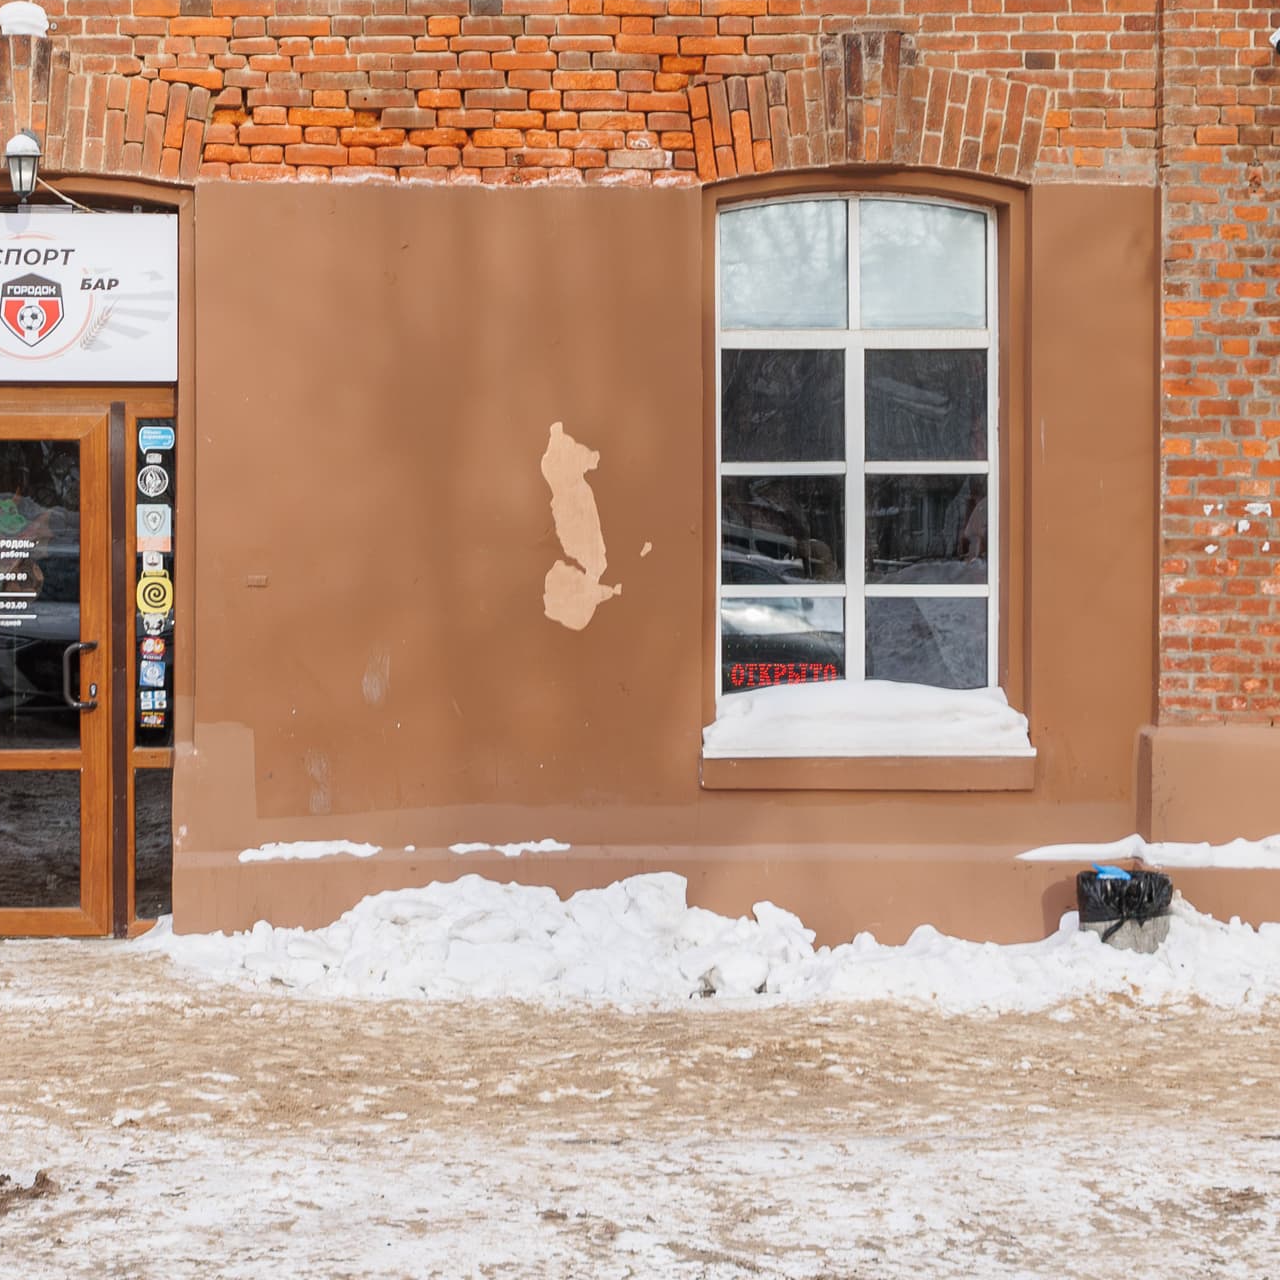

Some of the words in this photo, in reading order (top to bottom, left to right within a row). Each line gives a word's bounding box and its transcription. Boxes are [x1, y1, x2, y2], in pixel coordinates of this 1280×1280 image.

[80, 278, 119, 291] БАР
[7, 285, 56, 297] ГОРОДОК
[0, 550, 29, 559] работы
[731, 663, 837, 686] ОТКРЫТО
